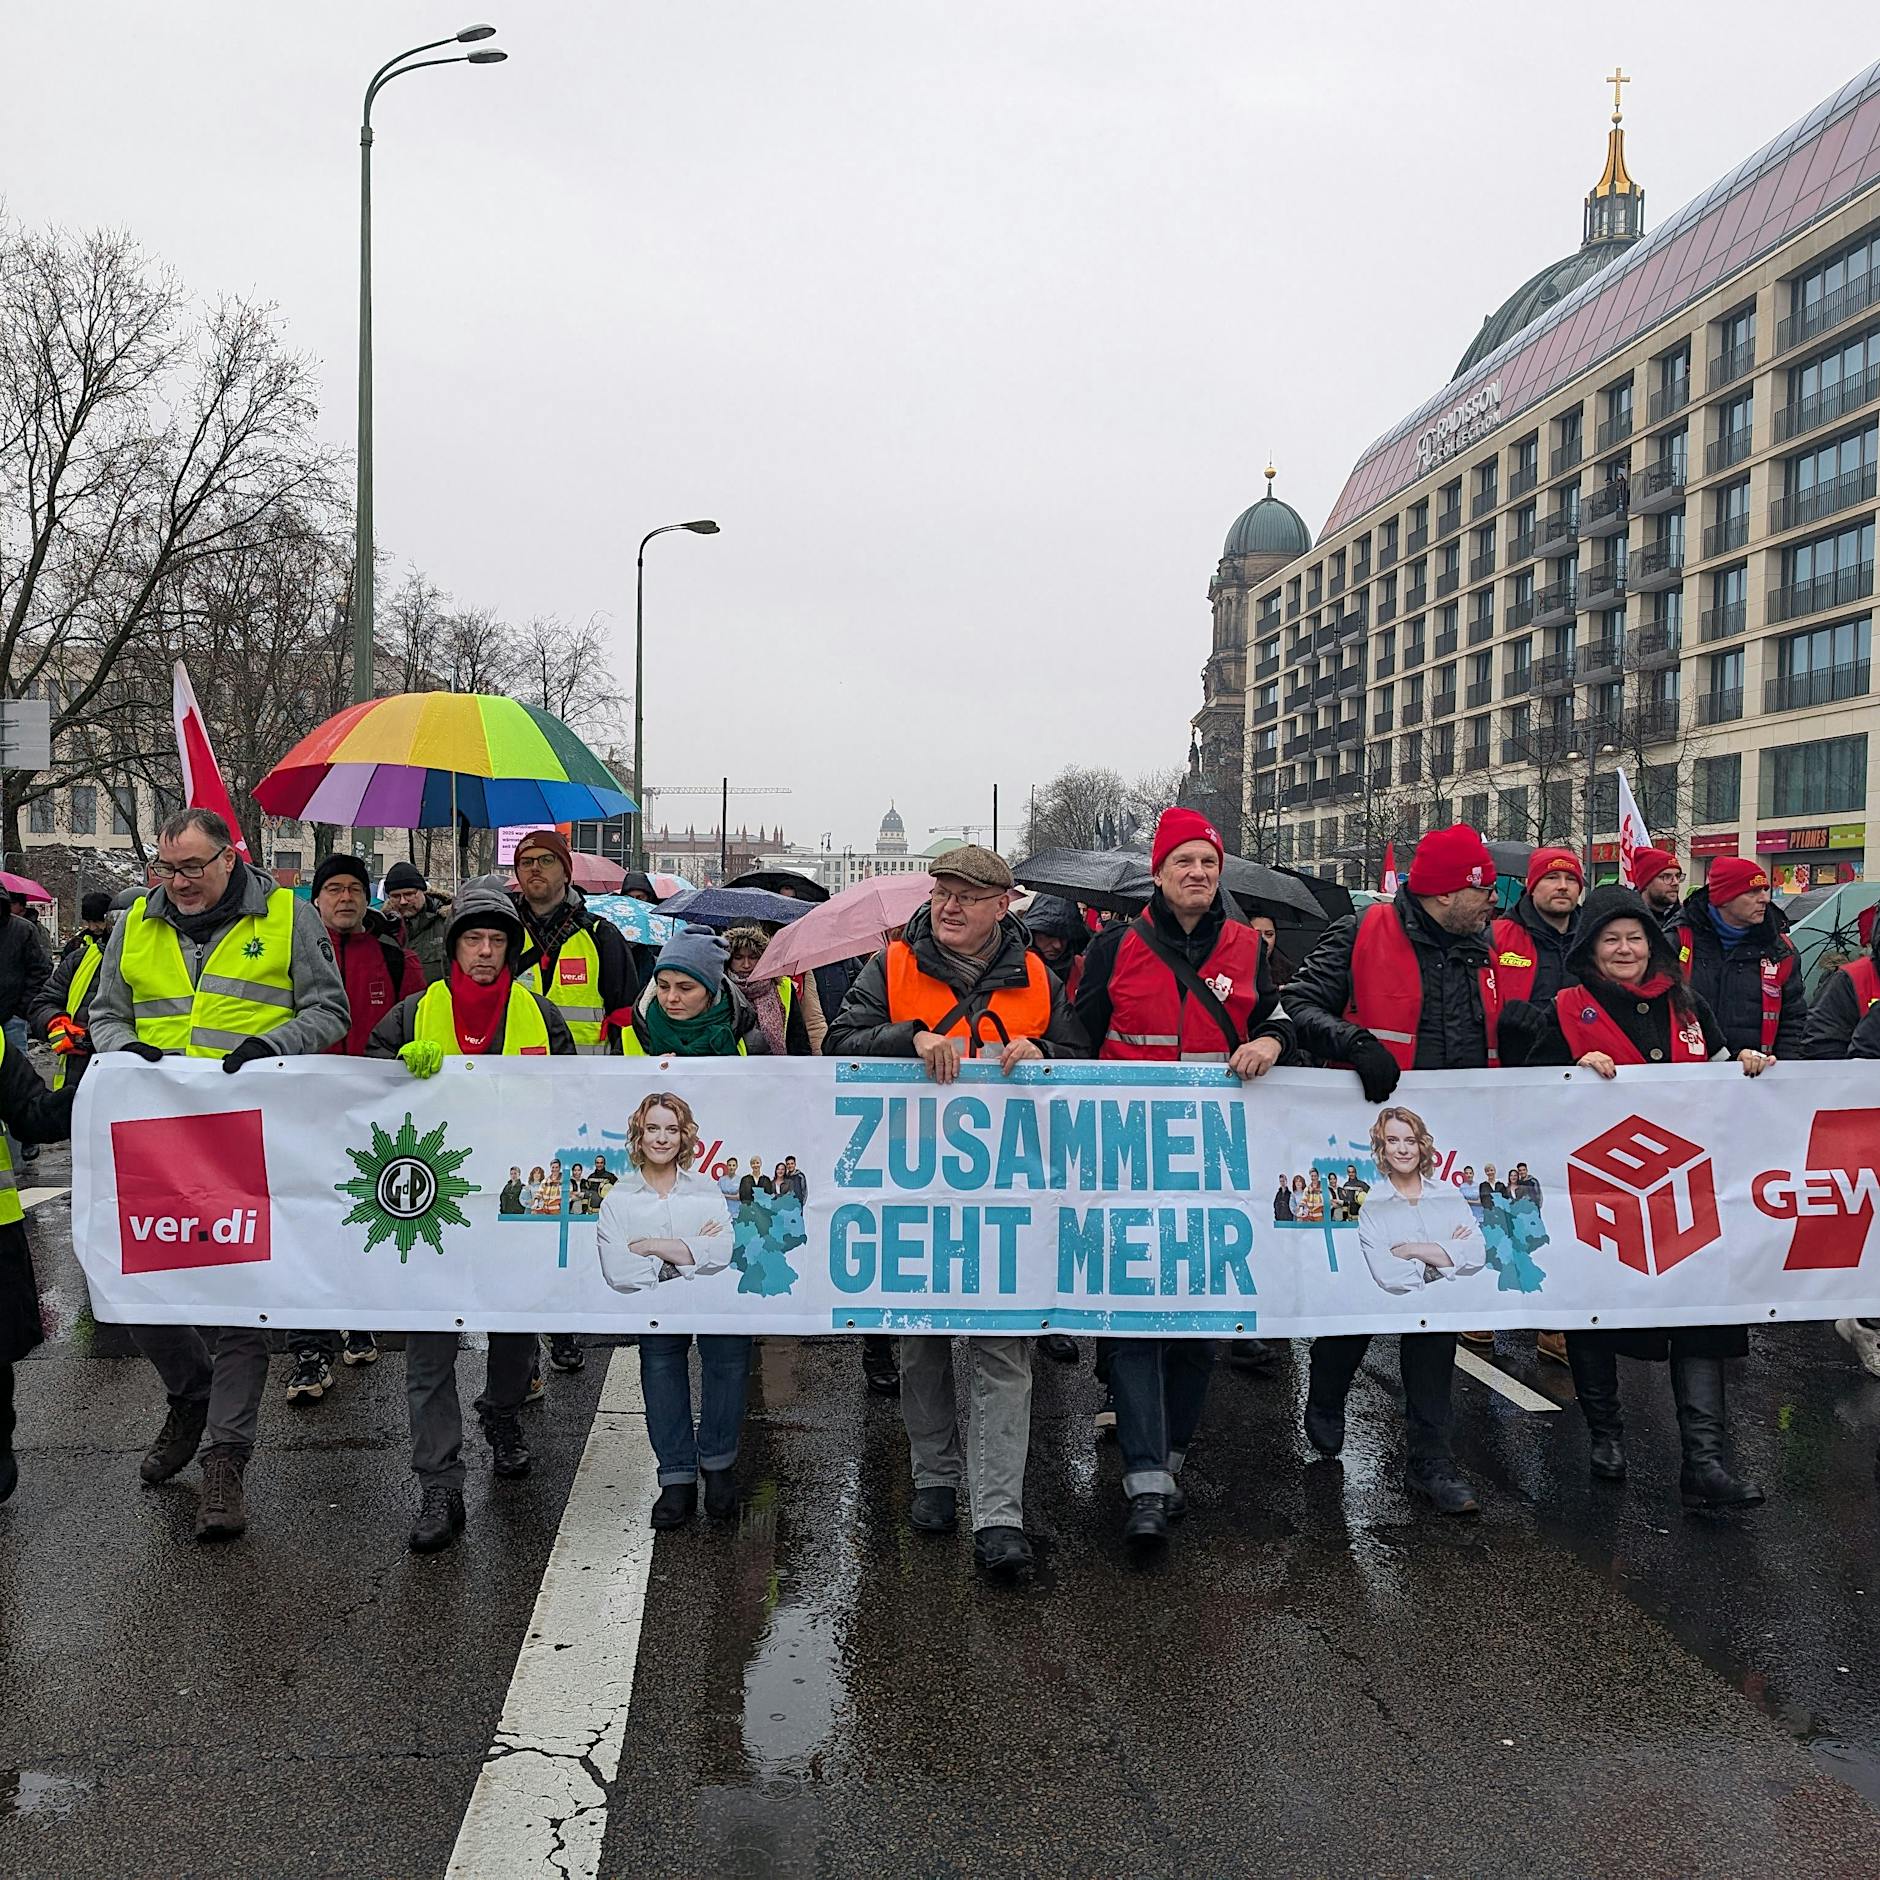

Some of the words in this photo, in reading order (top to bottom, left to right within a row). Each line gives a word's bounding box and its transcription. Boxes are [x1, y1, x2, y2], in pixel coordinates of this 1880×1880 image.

[1437, 379, 1503, 441] RADISSON
[1437, 409, 1501, 460] COLLECTION
[1789, 829, 1828, 849] PYLONES
[561, 973, 586, 981] ver.di
[833, 1096, 1251, 1192] ZUSAMMEN
[385, 1166, 427, 1210] GdP
[1751, 1168, 1880, 1220] GEW
[128, 1208, 257, 1245] ver.di
[829, 1203, 1032, 1295] GEHT
[1057, 1206, 1258, 1297] MEHR
